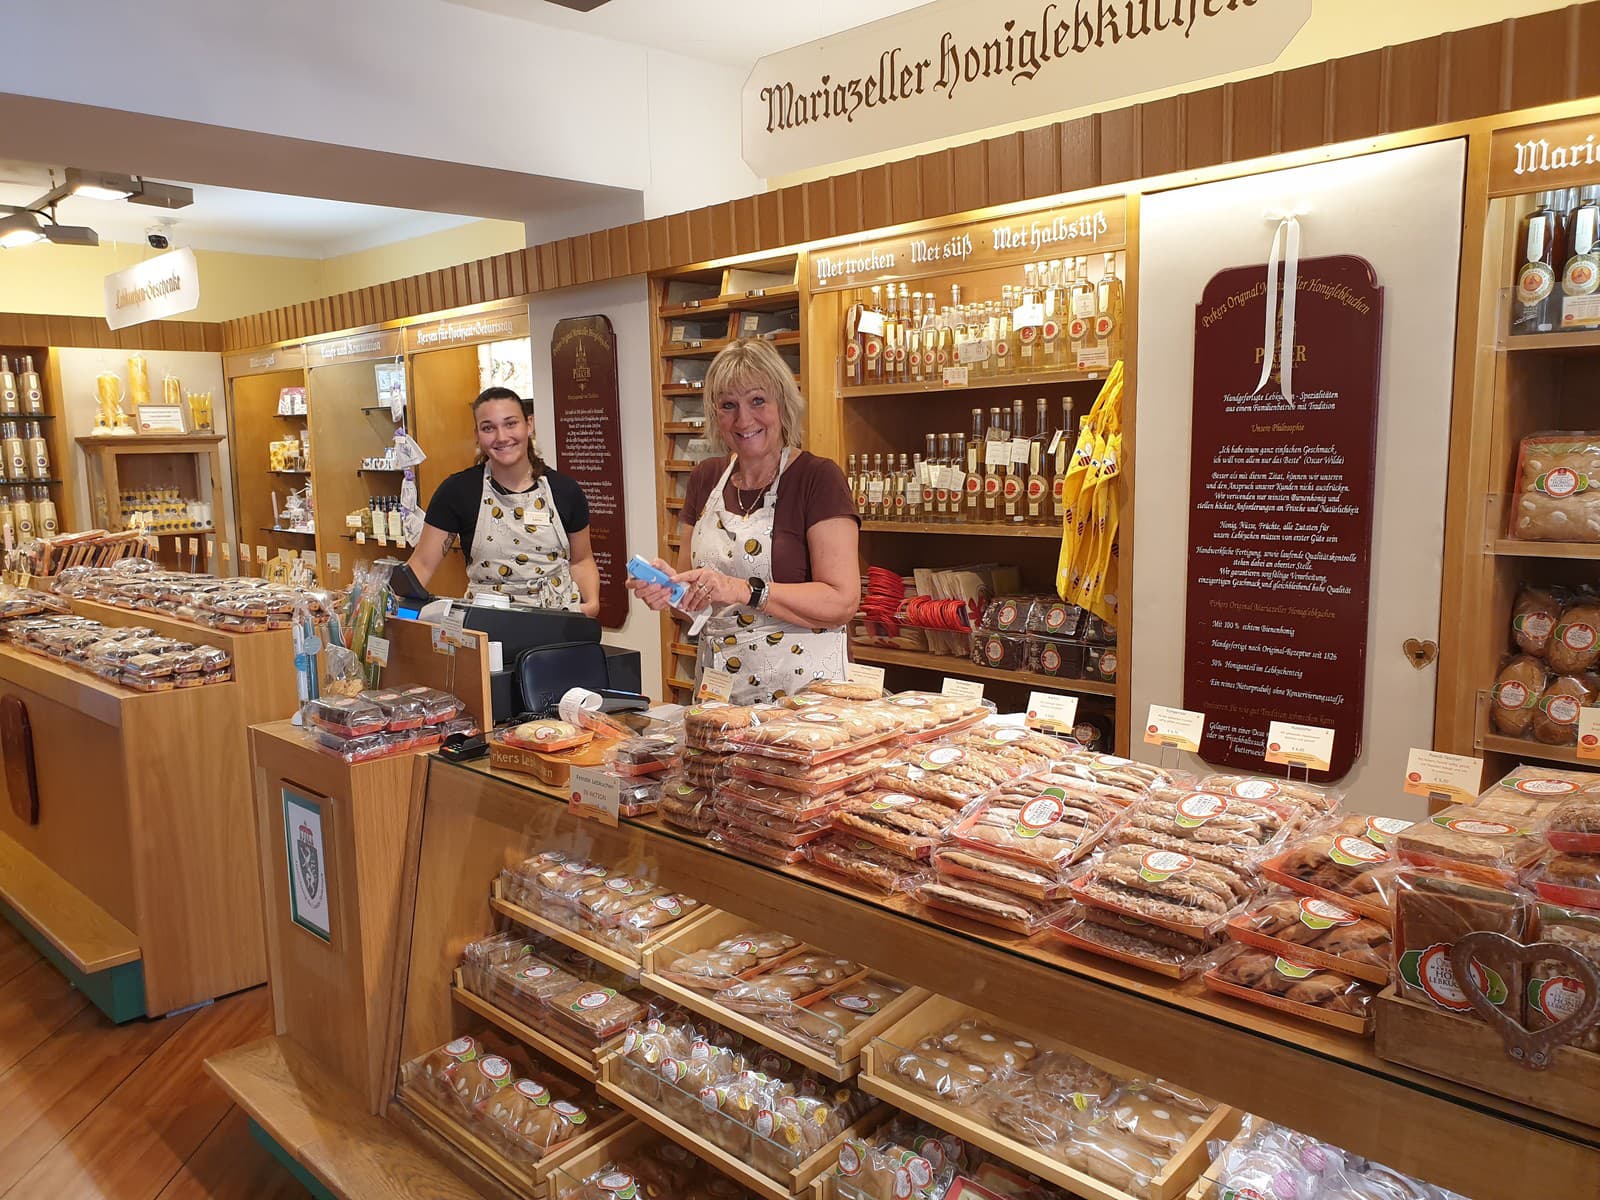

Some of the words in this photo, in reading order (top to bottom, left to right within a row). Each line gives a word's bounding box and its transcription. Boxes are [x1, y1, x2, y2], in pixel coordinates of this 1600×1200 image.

[760, 48, 931, 133] Mariazeller
[933, 0, 1258, 99] Honiglebkuch
[816, 257, 843, 279] Met
[845, 249, 895, 274] trocken
[910, 240, 941, 263] Met
[943, 232, 973, 263] süß
[992, 225, 1028, 251] Met
[1030, 209, 1108, 254] halbsüß
[1227, 282, 1259, 309] Original
[1308, 278, 1370, 314] Honiglebkuchen
[1265, 393, 1295, 403] Lebkun
